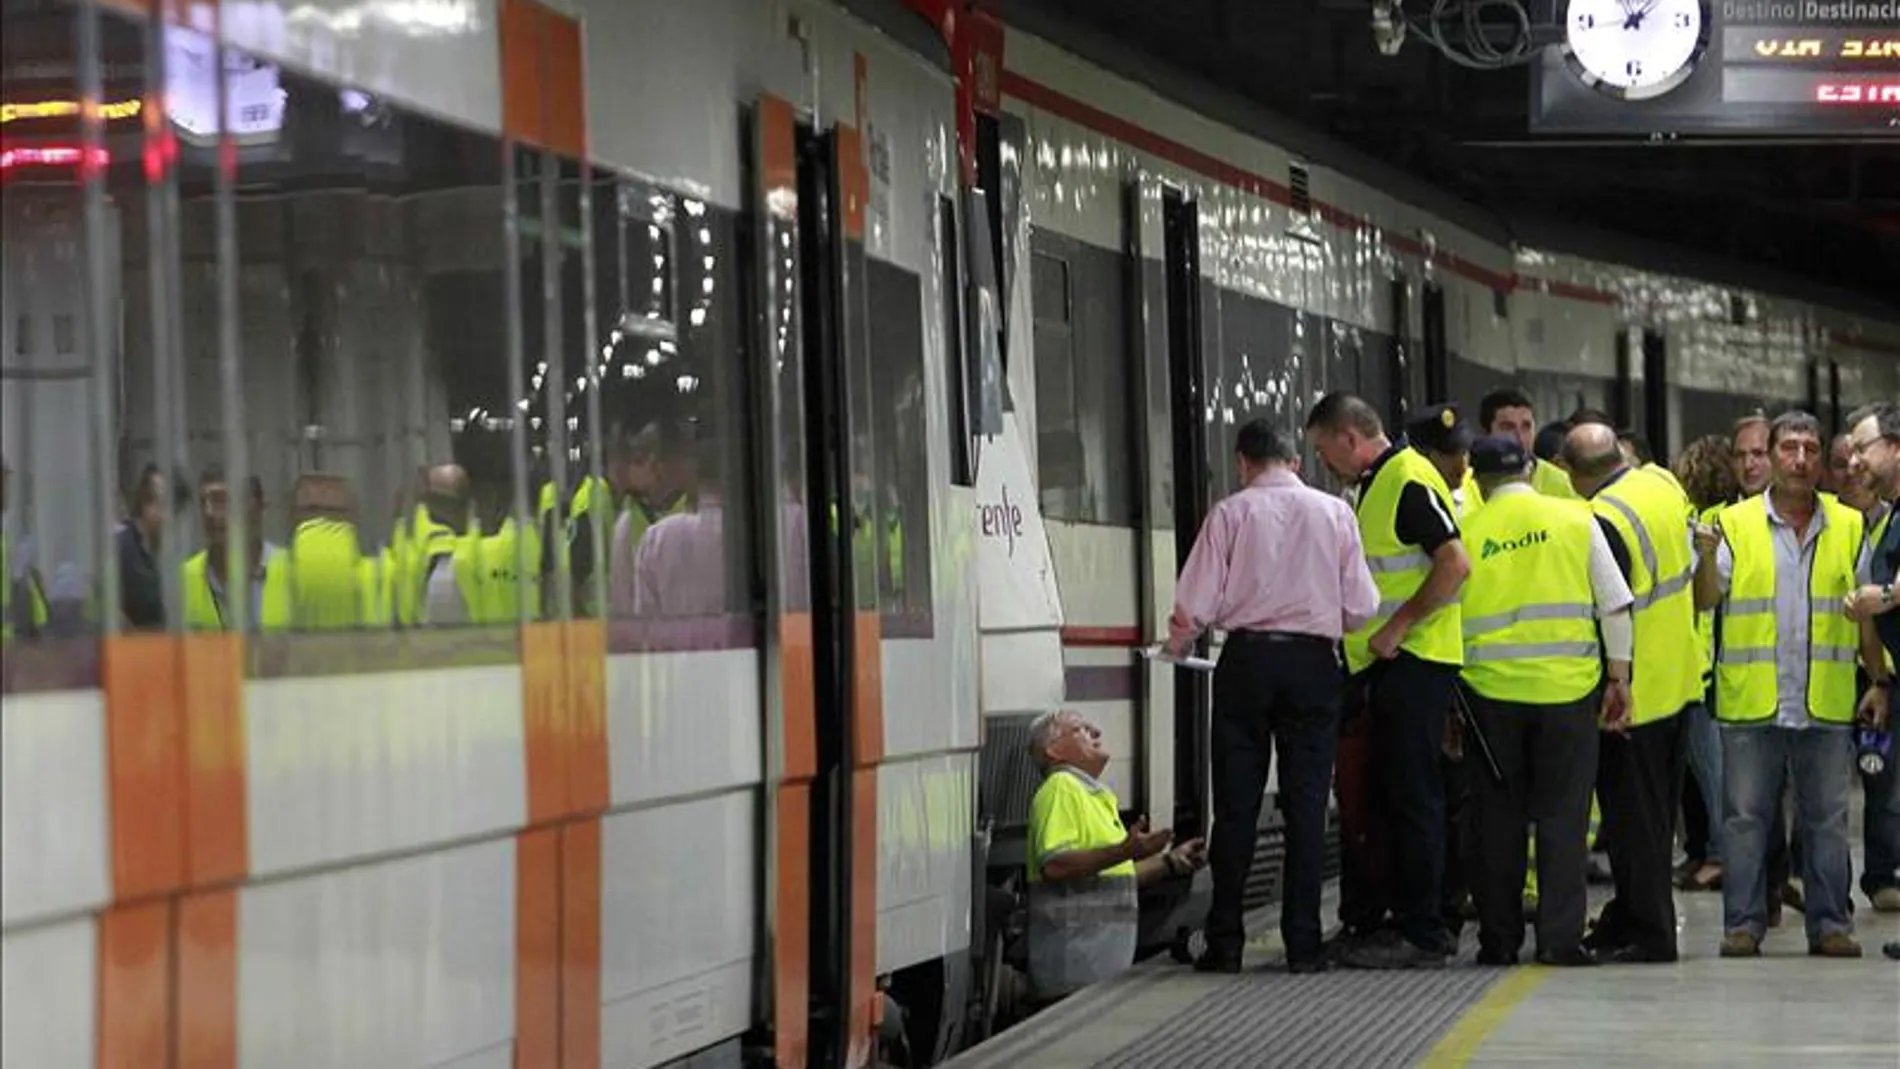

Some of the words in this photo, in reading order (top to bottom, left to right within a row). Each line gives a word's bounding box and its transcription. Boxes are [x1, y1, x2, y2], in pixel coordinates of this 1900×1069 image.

[1723, 0, 1795, 19] Destino
[1806, 0, 1900, 20] Destinaci
[1579, 14, 1594, 30] 9
[1675, 13, 1690, 28] 3
[1626, 61, 1642, 76] 6
[976, 484, 1023, 559] enfe
